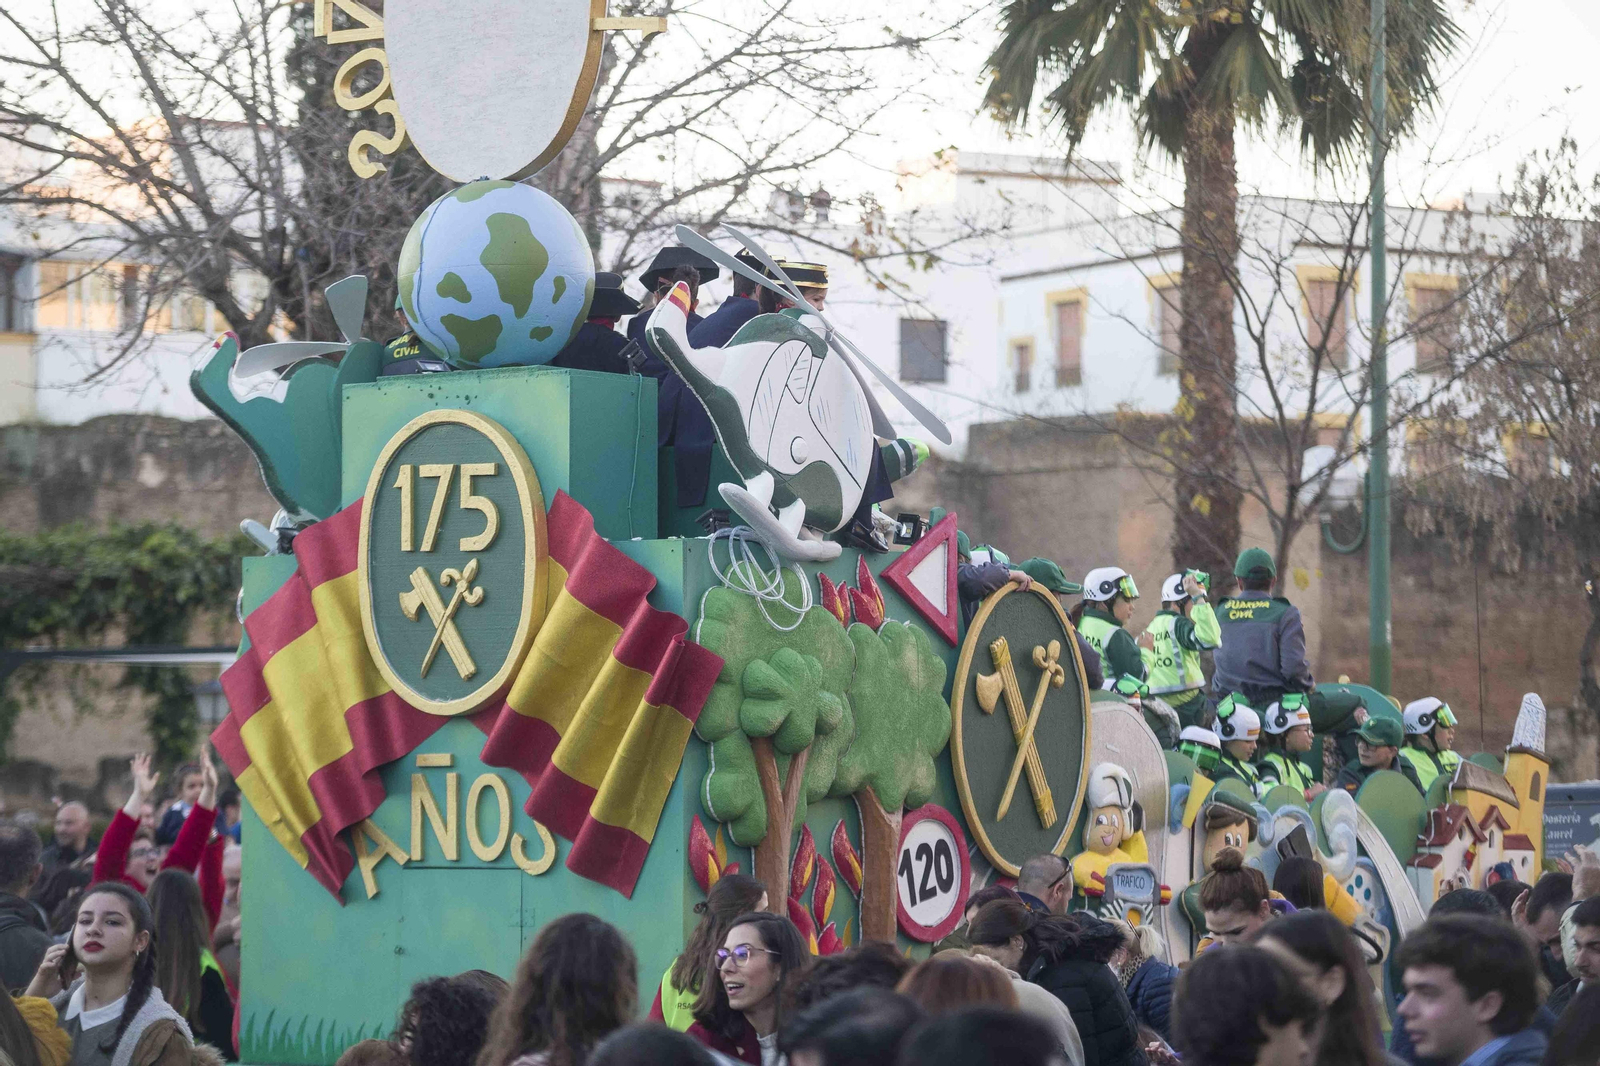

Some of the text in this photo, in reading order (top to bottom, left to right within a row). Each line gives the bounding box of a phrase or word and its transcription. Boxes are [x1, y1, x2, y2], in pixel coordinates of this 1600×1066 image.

[389, 334, 410, 349] GUA
[393, 345, 420, 358] CIVIL
[393, 463, 499, 552] 175
[1085, 635, 1102, 649] DIA
[1155, 630, 1171, 642] DIA
[351, 753, 557, 900] AÑOS
[898, 838, 955, 908] 120
[1116, 874, 1146, 890] TRAFICO
